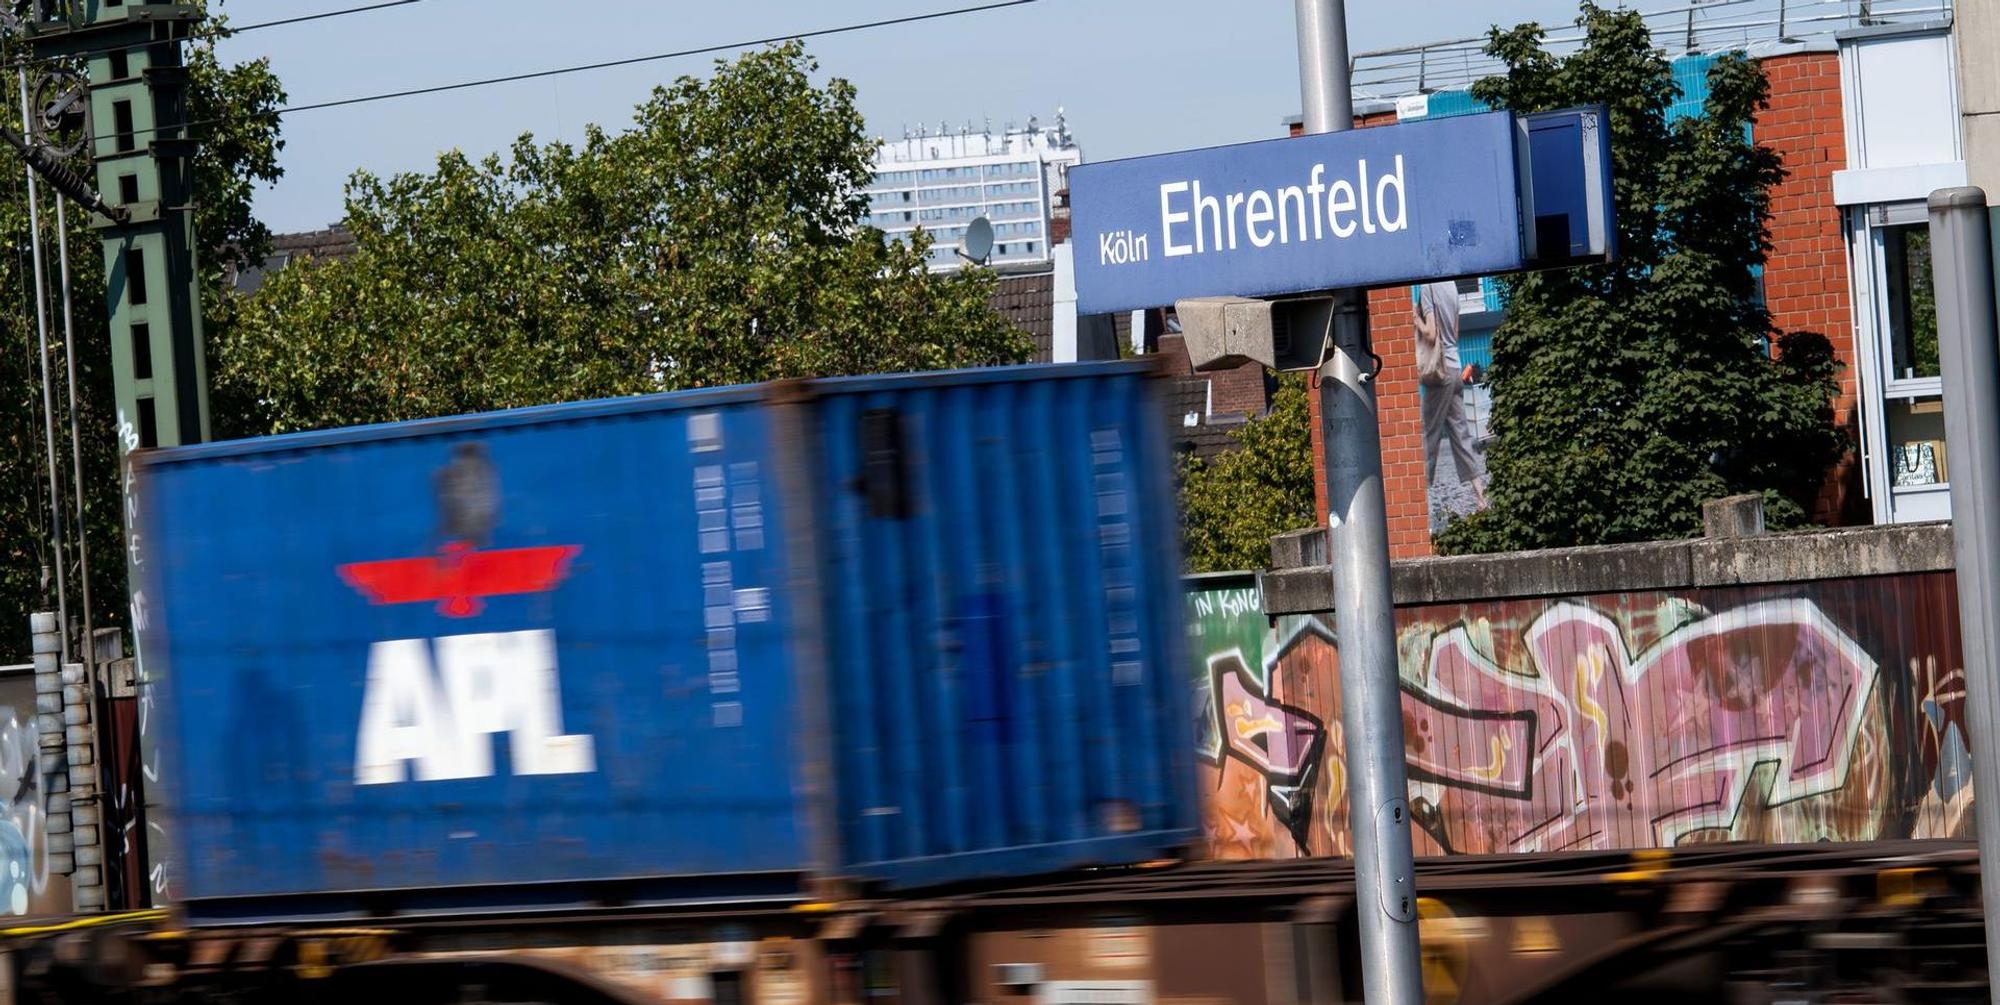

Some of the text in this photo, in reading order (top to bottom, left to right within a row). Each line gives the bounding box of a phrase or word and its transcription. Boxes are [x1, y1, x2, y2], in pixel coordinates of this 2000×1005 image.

[1099, 154, 1408, 266] Köln Ehrenfeld
[353, 628, 598, 785] APL
